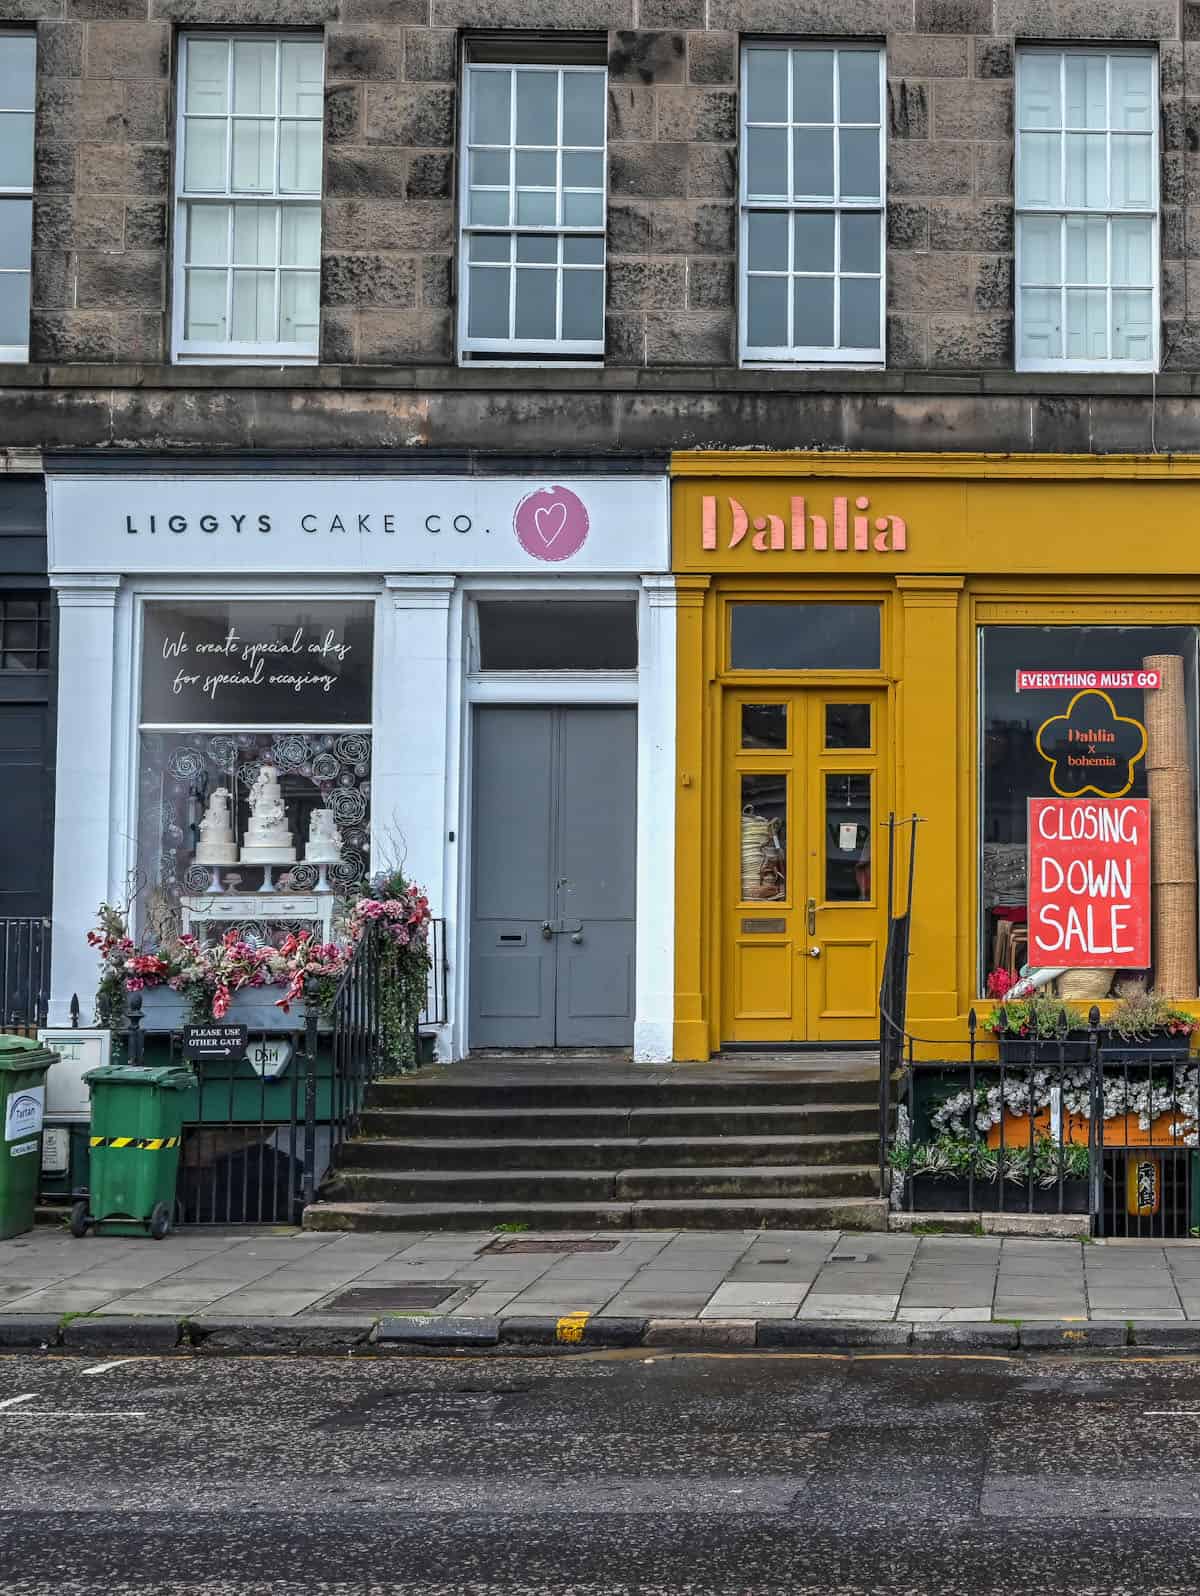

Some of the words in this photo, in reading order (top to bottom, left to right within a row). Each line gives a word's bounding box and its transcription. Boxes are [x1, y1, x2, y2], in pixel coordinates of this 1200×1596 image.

[126, 514, 273, 534] LIGGYS
[301, 514, 395, 534] CAKE
[425, 514, 492, 534] CO.
[702, 496, 907, 552] Dahlia
[163, 632, 188, 659] We
[196, 628, 240, 656] create
[242, 628, 304, 668] special
[308, 629, 351, 660] cakes
[173, 669, 200, 694] for
[203, 658, 264, 699] special
[269, 672, 337, 691] occasions
[1021, 674, 1097, 687] EVERYTHING
[1101, 674, 1134, 686] MUST
[1137, 673, 1157, 686] GO
[1068, 729, 1115, 742] Dahlia
[1068, 756, 1116, 766] bohemia
[1038, 804, 1138, 845] CLOSING
[1041, 856, 1132, 901] DOWN
[1035, 903, 1135, 954] SALE
[220, 1038, 242, 1046] GATE
